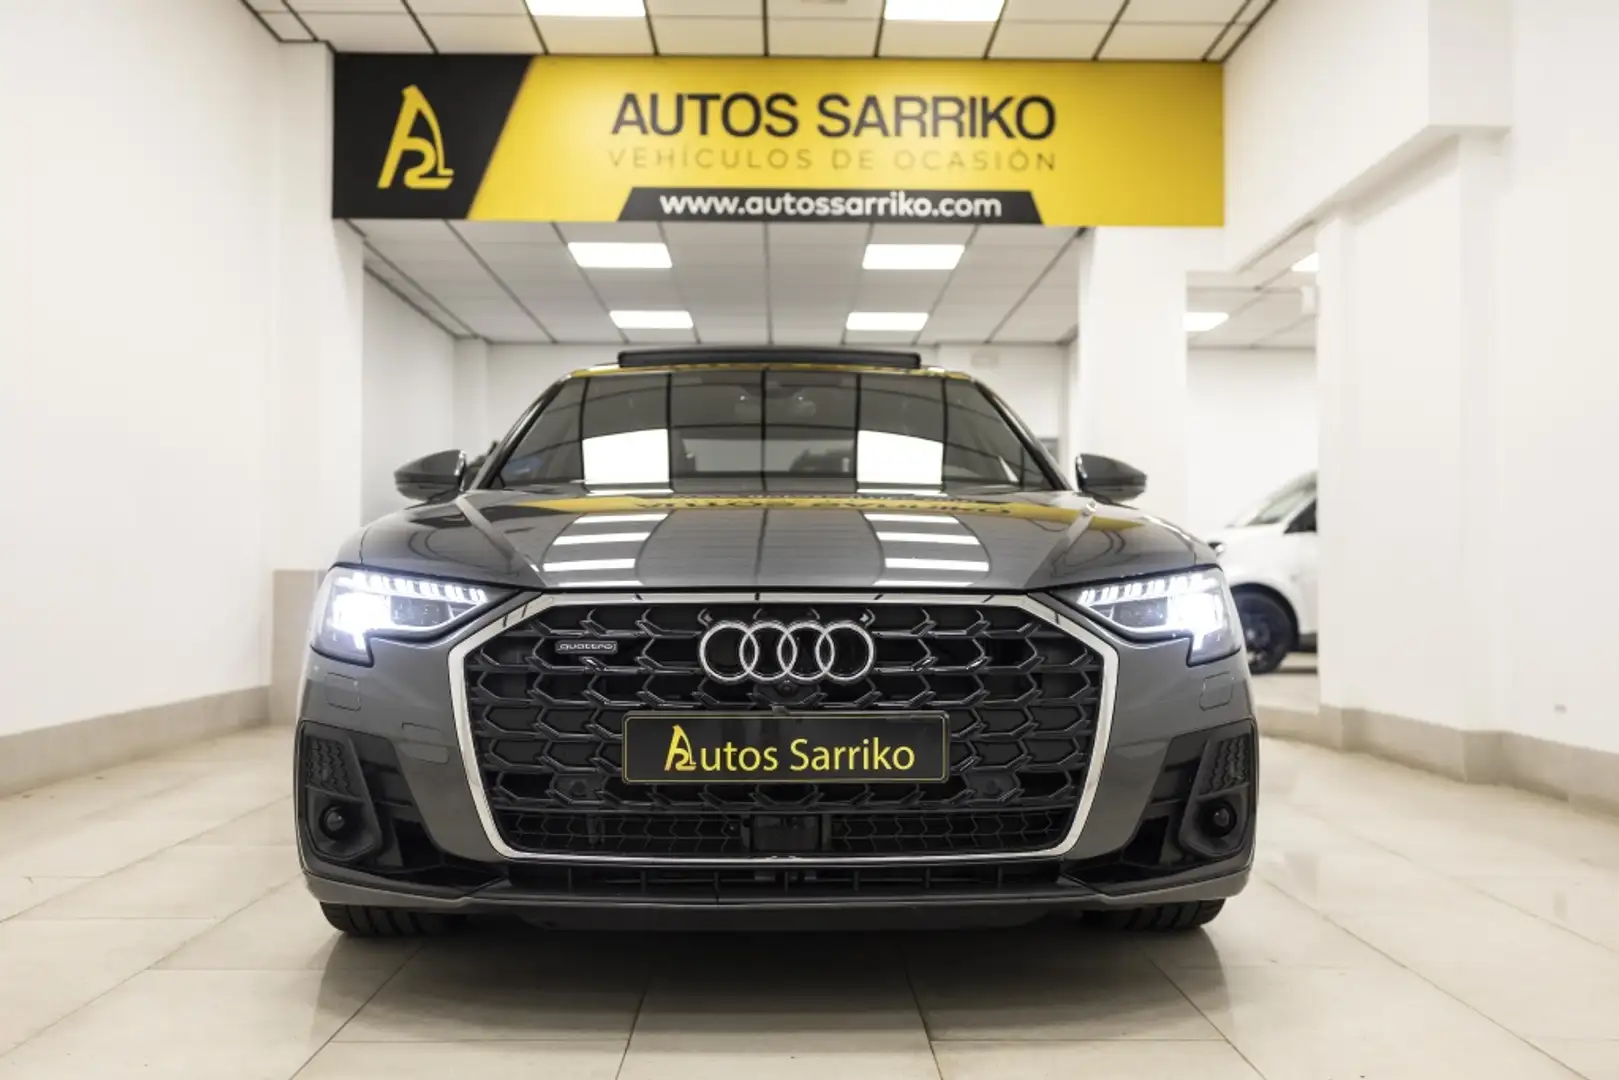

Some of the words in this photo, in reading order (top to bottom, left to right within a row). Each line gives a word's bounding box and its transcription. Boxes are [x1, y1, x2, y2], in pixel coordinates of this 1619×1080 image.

[611, 91, 798, 138] AUTOS
[817, 93, 1056, 140] SARRIKO
[608, 144, 813, 169] VEHÍCULOS
[832, 149, 874, 170] DE
[894, 146, 1056, 172] OCASIÓN
[659, 190, 1003, 218] www.autossarriko.com
[559, 643, 614, 651] quattro
[789, 736, 915, 772] Sarriko
